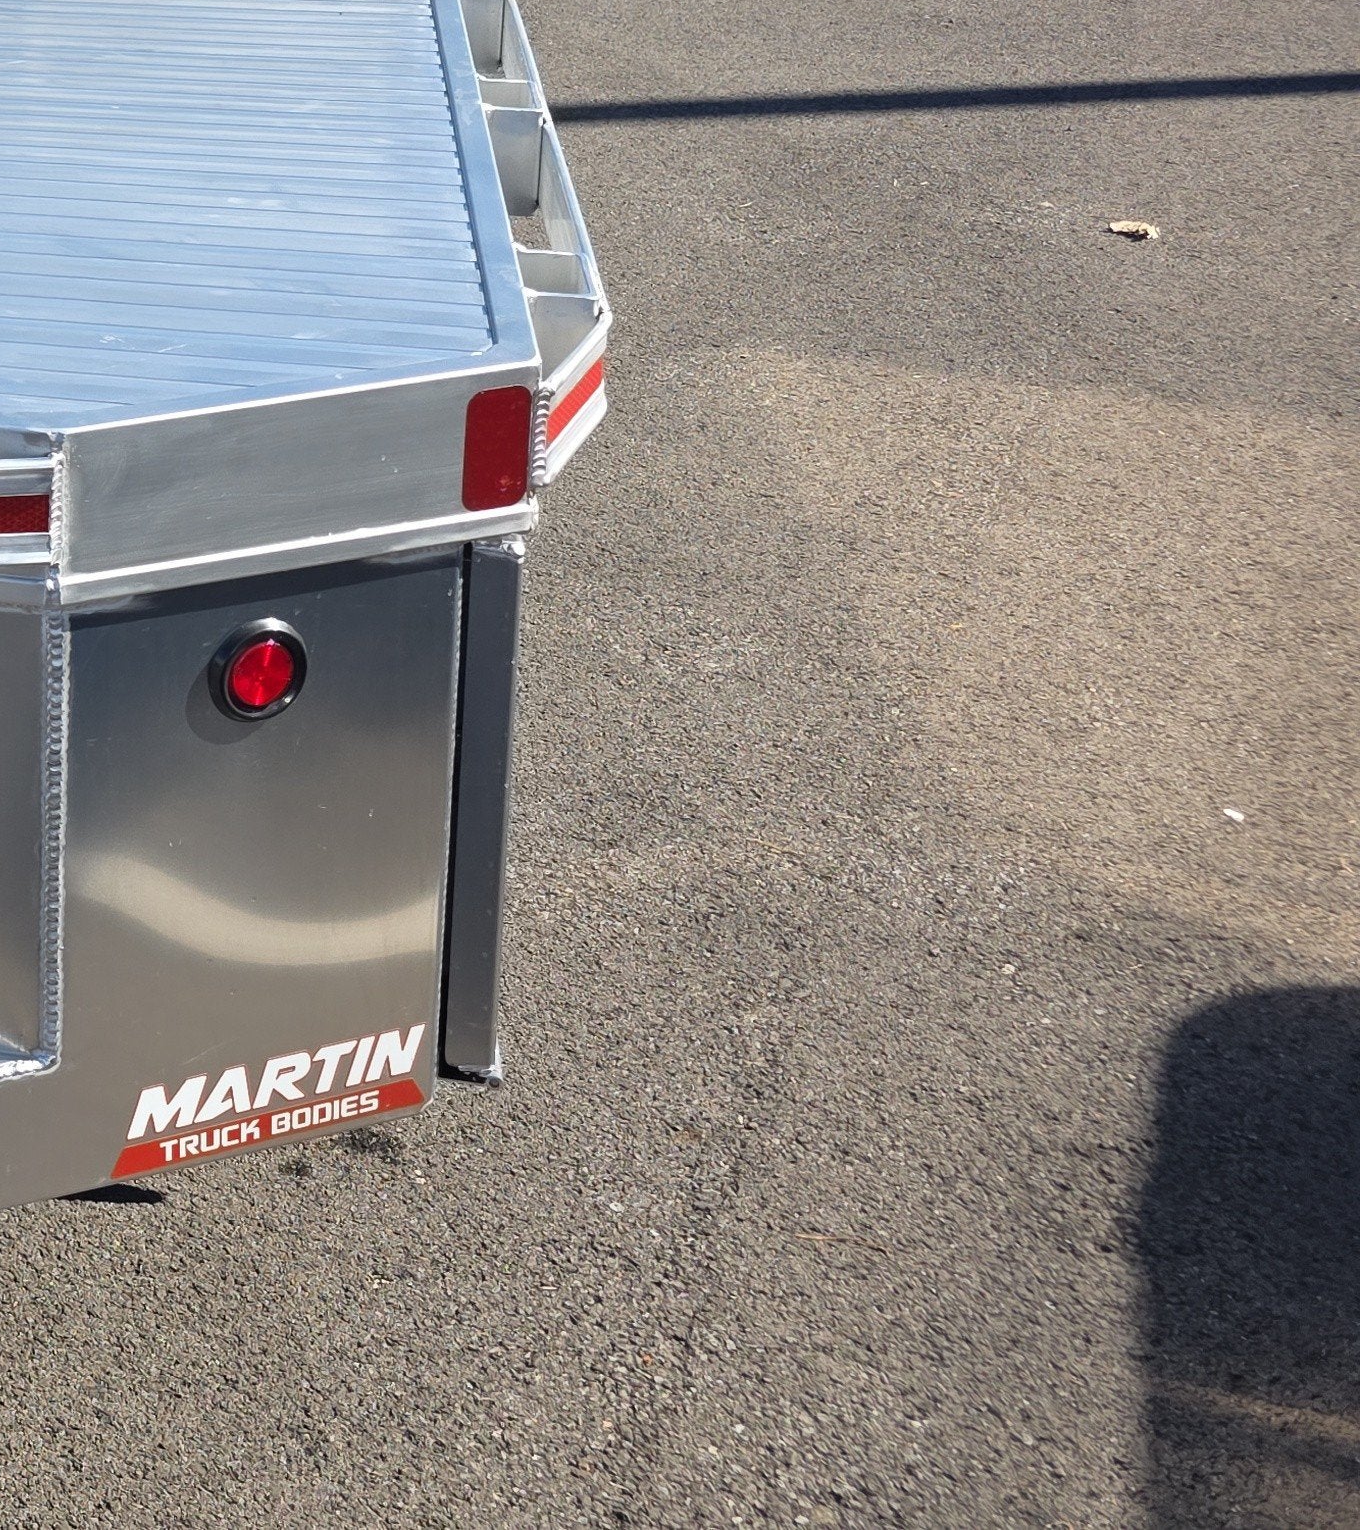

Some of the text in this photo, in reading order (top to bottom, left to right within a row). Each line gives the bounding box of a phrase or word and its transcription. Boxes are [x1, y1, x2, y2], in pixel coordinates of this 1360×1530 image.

[126, 1022, 428, 1141] MARTIN
[159, 1089, 380, 1163] TRUCK BODIES
